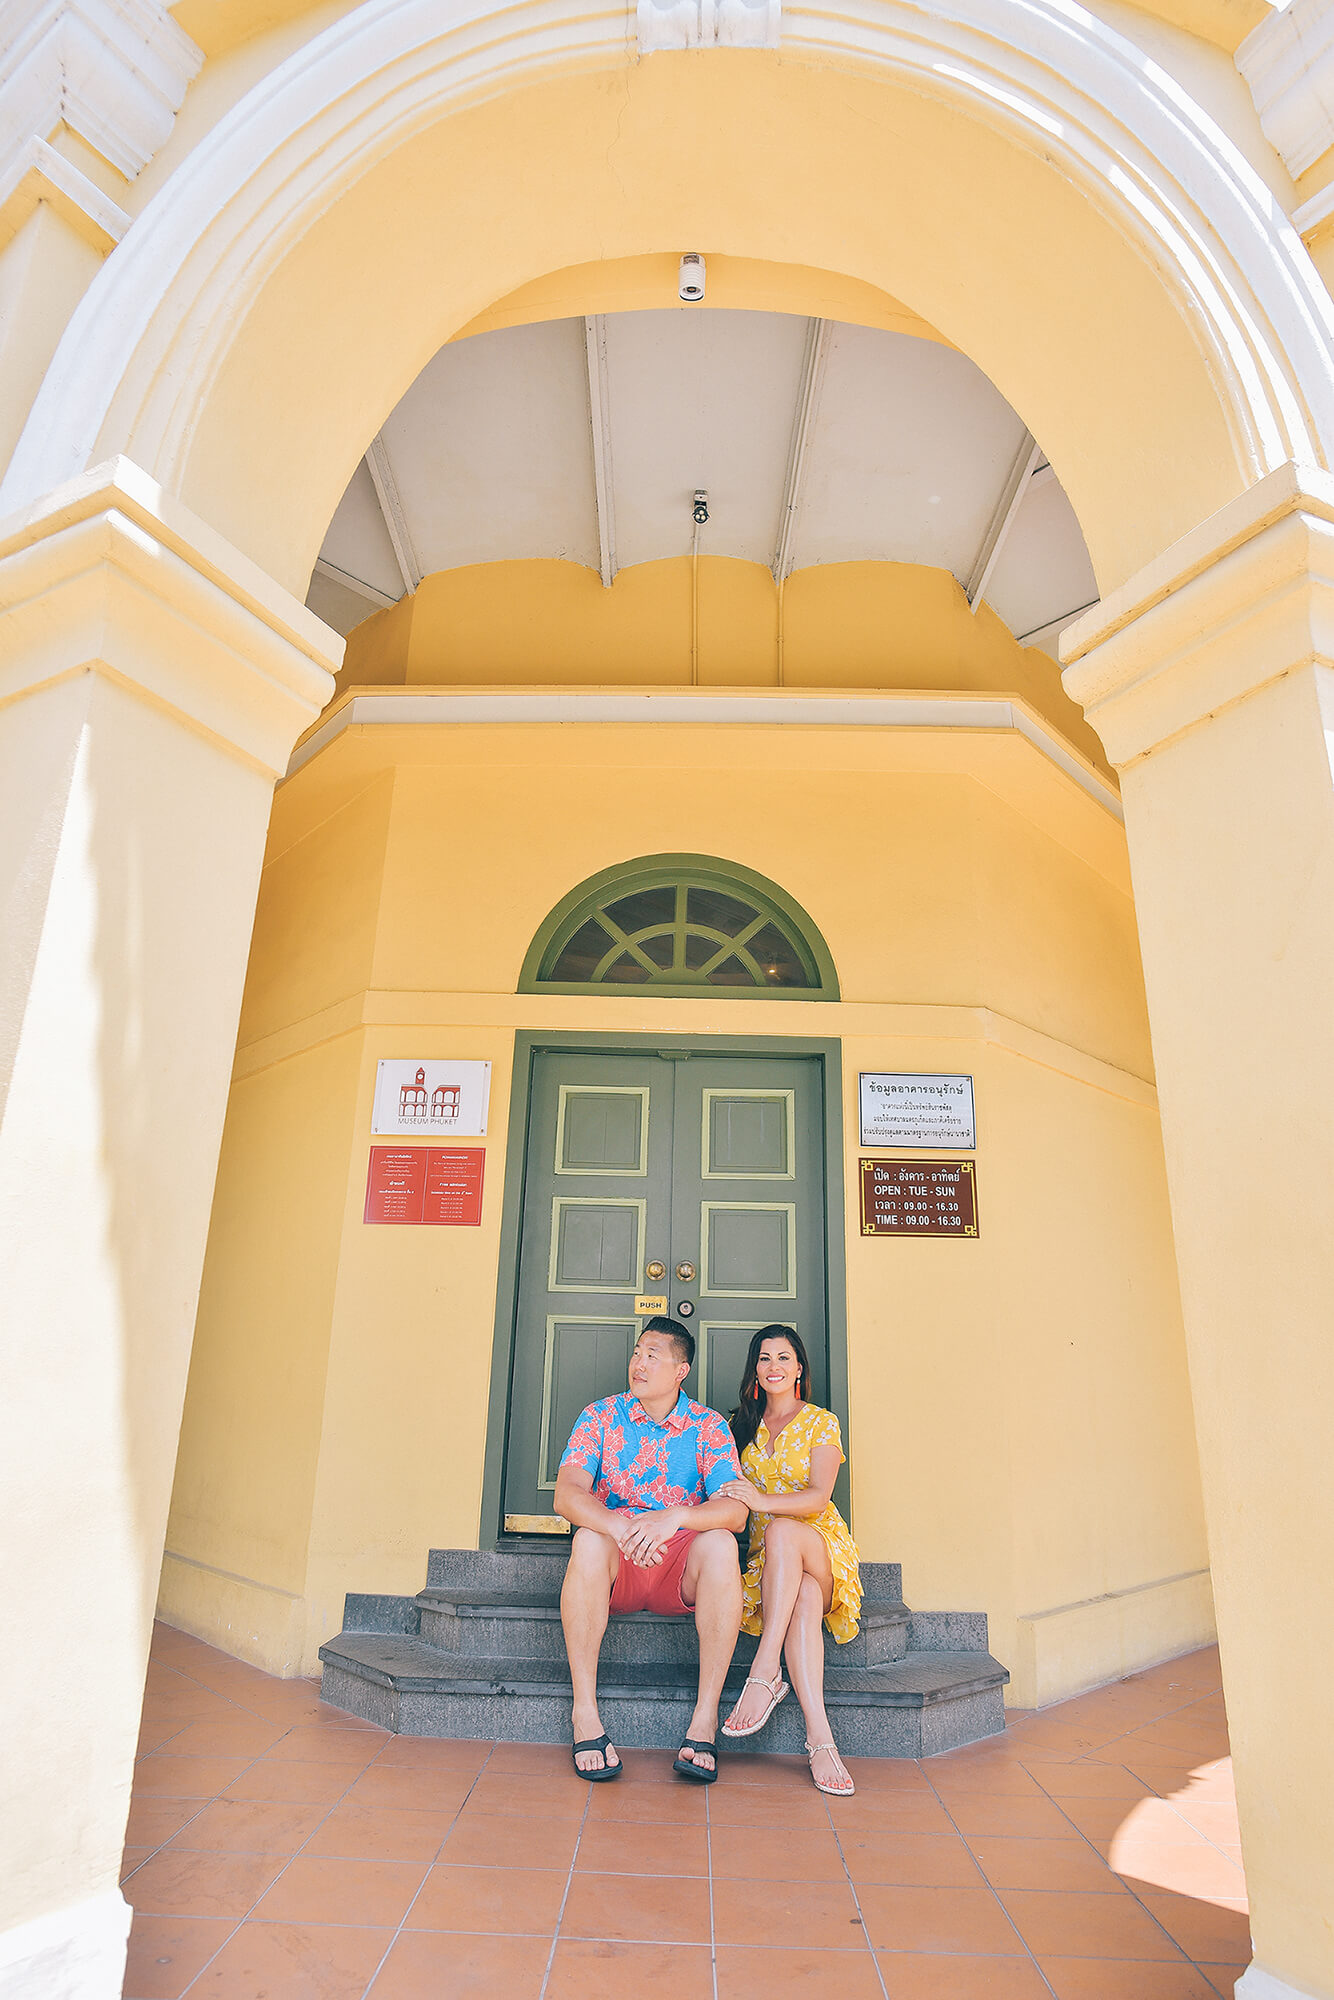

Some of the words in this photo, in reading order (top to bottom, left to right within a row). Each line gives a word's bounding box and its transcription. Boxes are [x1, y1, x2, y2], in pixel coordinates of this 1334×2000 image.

[869, 1081, 964, 1097] ข้อมูลอาคารอนุรักษ์
[874, 1167, 890, 1181] เปิด
[899, 1168, 924, 1181] อังคาร
[931, 1168, 961, 1182] อาทิตย์
[874, 1185, 901, 1196] OPEN
[908, 1185, 928, 1196] TUE
[935, 1186, 955, 1197] SUN
[875, 1200, 896, 1210] เวลา
[904, 1202, 927, 1211] 09.00
[936, 1202, 959, 1211] 16.30
[875, 1214, 898, 1224] TIME
[905, 1215, 930, 1225] 09.00
[937, 1216, 961, 1226] 16.30
